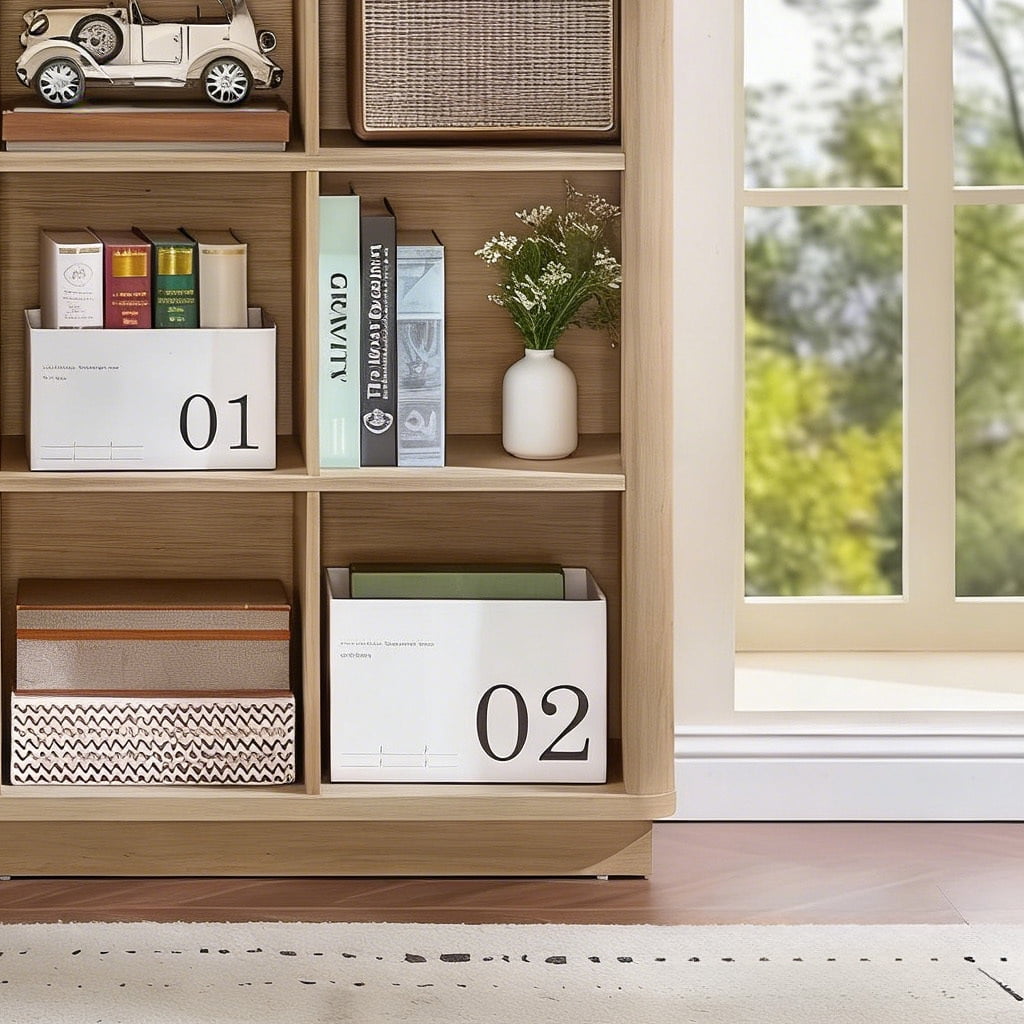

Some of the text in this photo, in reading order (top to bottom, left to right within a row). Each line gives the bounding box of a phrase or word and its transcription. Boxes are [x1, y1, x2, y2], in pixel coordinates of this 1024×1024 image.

[329, 272, 348, 383] GRAVITY
[179, 393, 259, 451] 01
[476, 684, 590, 762] 02
